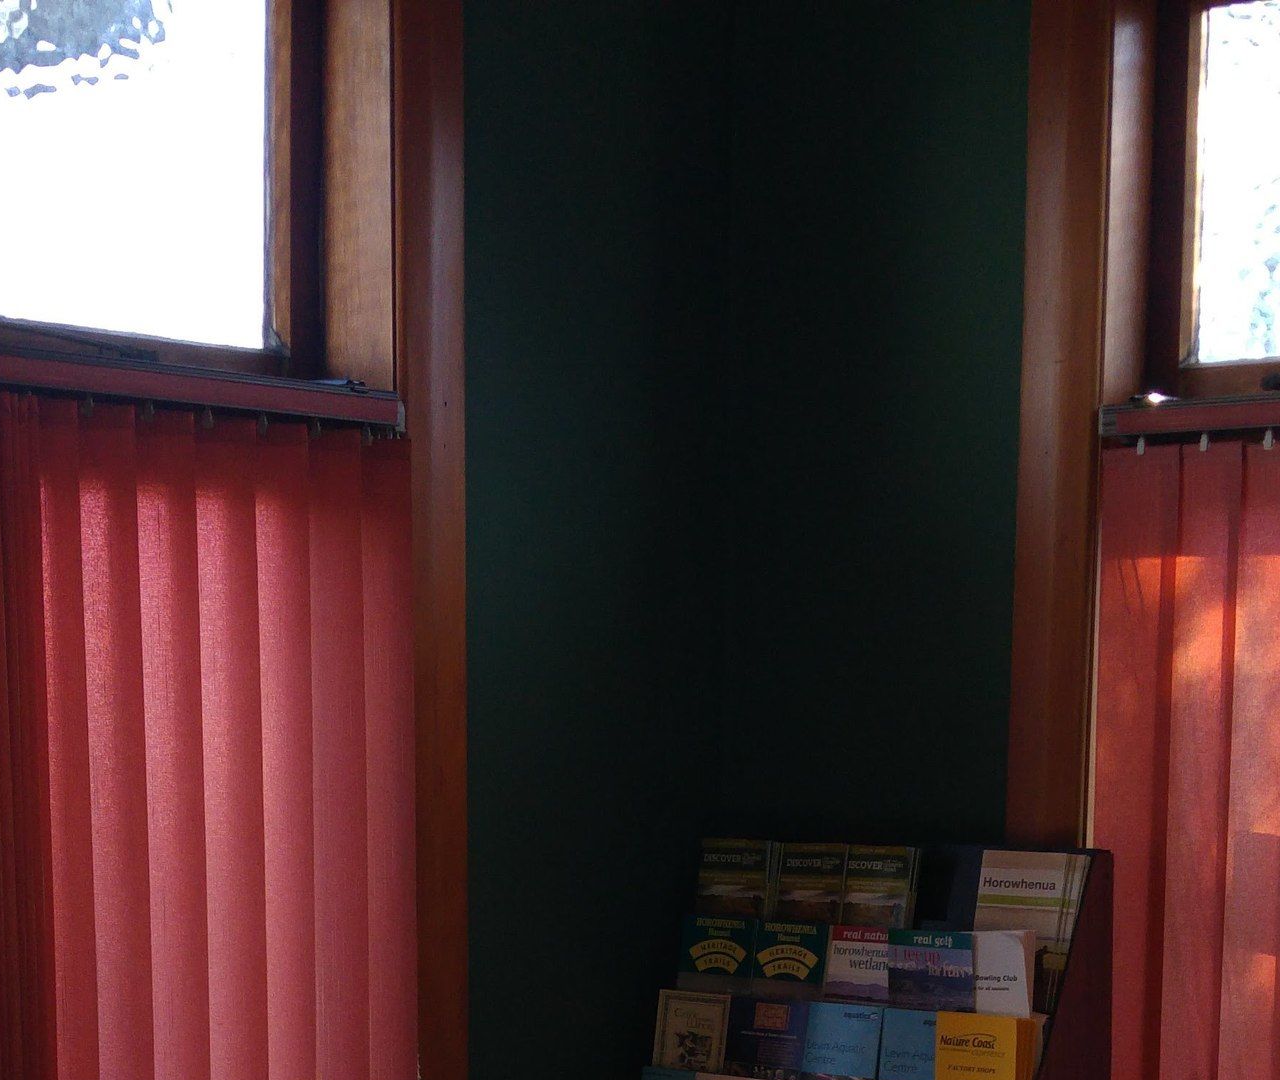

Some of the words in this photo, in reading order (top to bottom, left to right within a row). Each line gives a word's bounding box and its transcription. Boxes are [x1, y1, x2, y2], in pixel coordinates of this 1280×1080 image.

[983, 876, 1056, 893] Horowhenua
[914, 934, 933, 946] real
[935, 935, 955, 949] golf
[1003, 974, 1019, 983] Club
[940, 1034, 971, 1049] Nature
